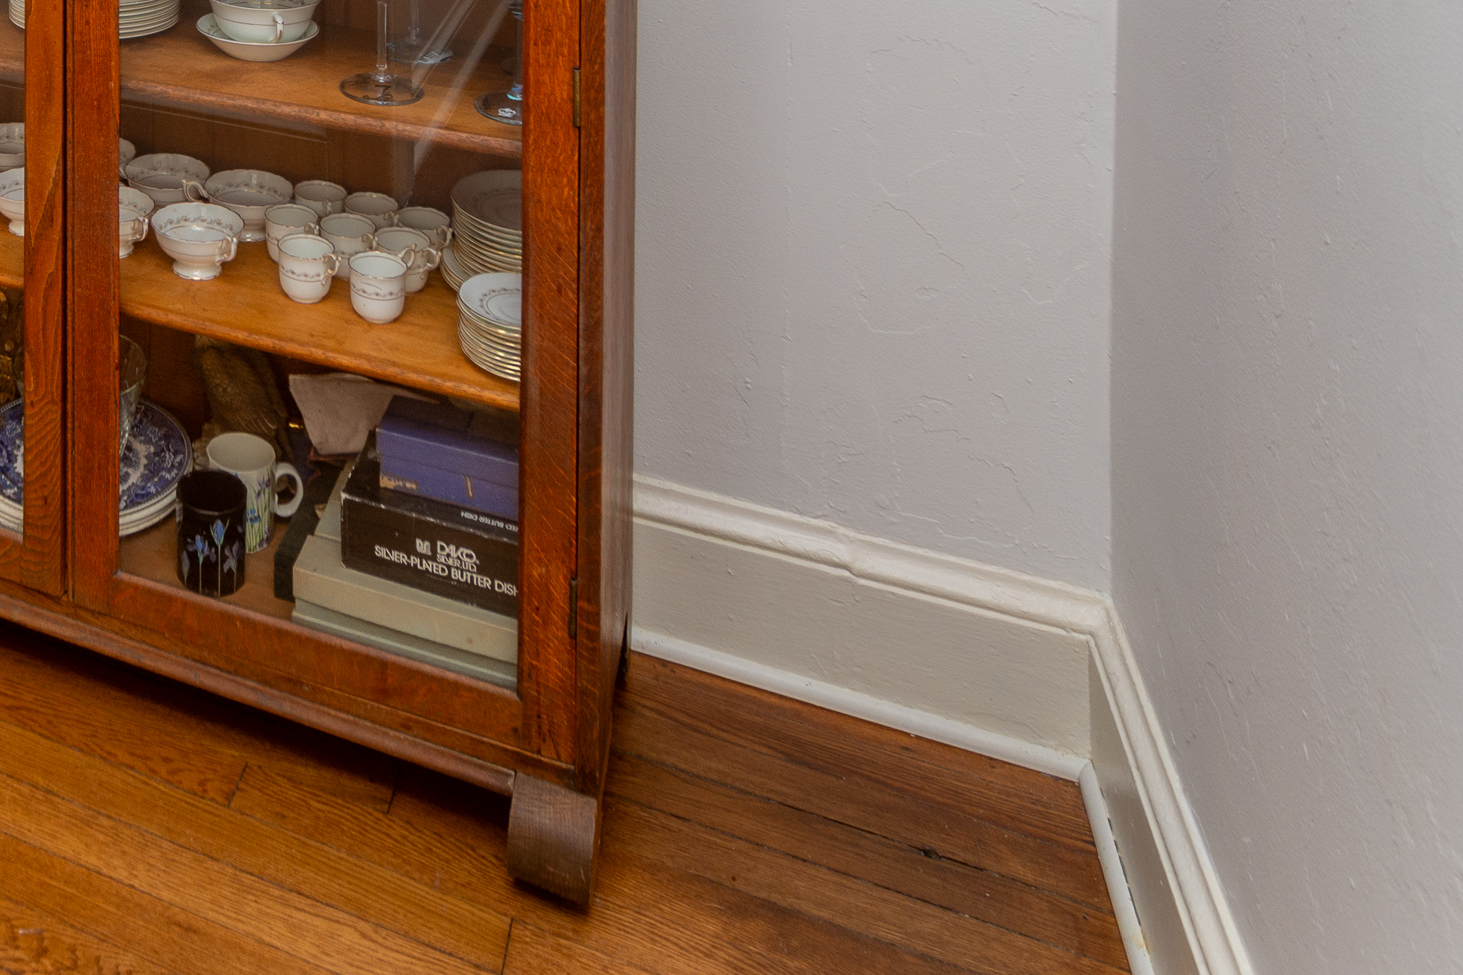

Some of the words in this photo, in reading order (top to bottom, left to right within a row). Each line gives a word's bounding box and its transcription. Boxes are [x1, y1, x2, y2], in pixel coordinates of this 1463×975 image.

[478, 516, 504, 529] BUTTER
[374, 544, 449, 577] SILVER-PLATED
[450, 567, 492, 590] BUTTER
